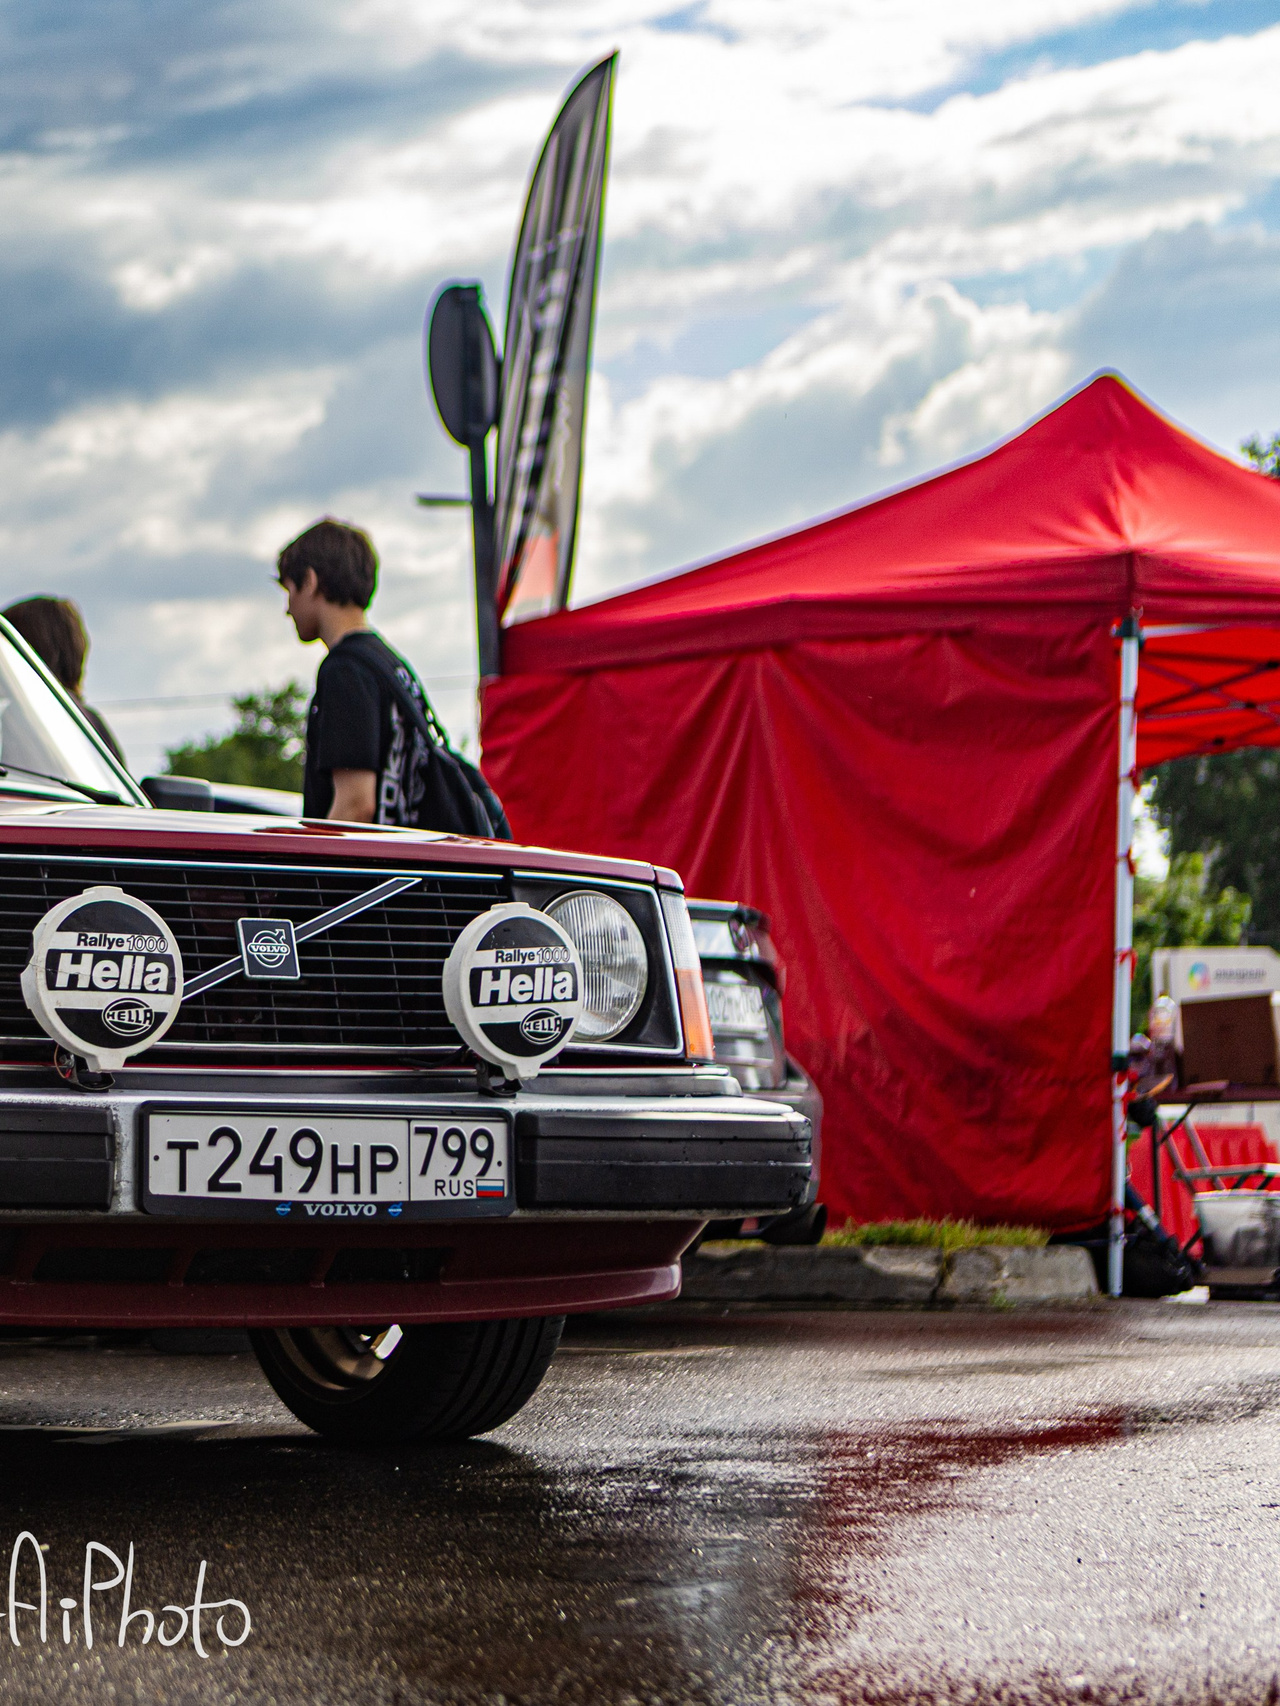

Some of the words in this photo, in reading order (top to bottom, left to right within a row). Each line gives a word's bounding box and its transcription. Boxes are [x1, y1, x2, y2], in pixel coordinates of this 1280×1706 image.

[76, 933, 125, 950] Rallye
[127, 935, 169, 954] 1000
[250, 944, 288, 953] VOLVO
[495, 949, 536, 965] Rallye
[536, 947, 571, 964] 1000
[55, 952, 169, 992] Hella
[478, 967, 573, 1004] Hella
[106, 1008, 153, 1026] HELLA
[523, 1016, 562, 1032] HELLA
[166, 1126, 400, 1195] T249HP
[414, 1126, 496, 1178] 799
[434, 1179, 475, 1197] RUS
[303, 1203, 378, 1217] VOLVO
